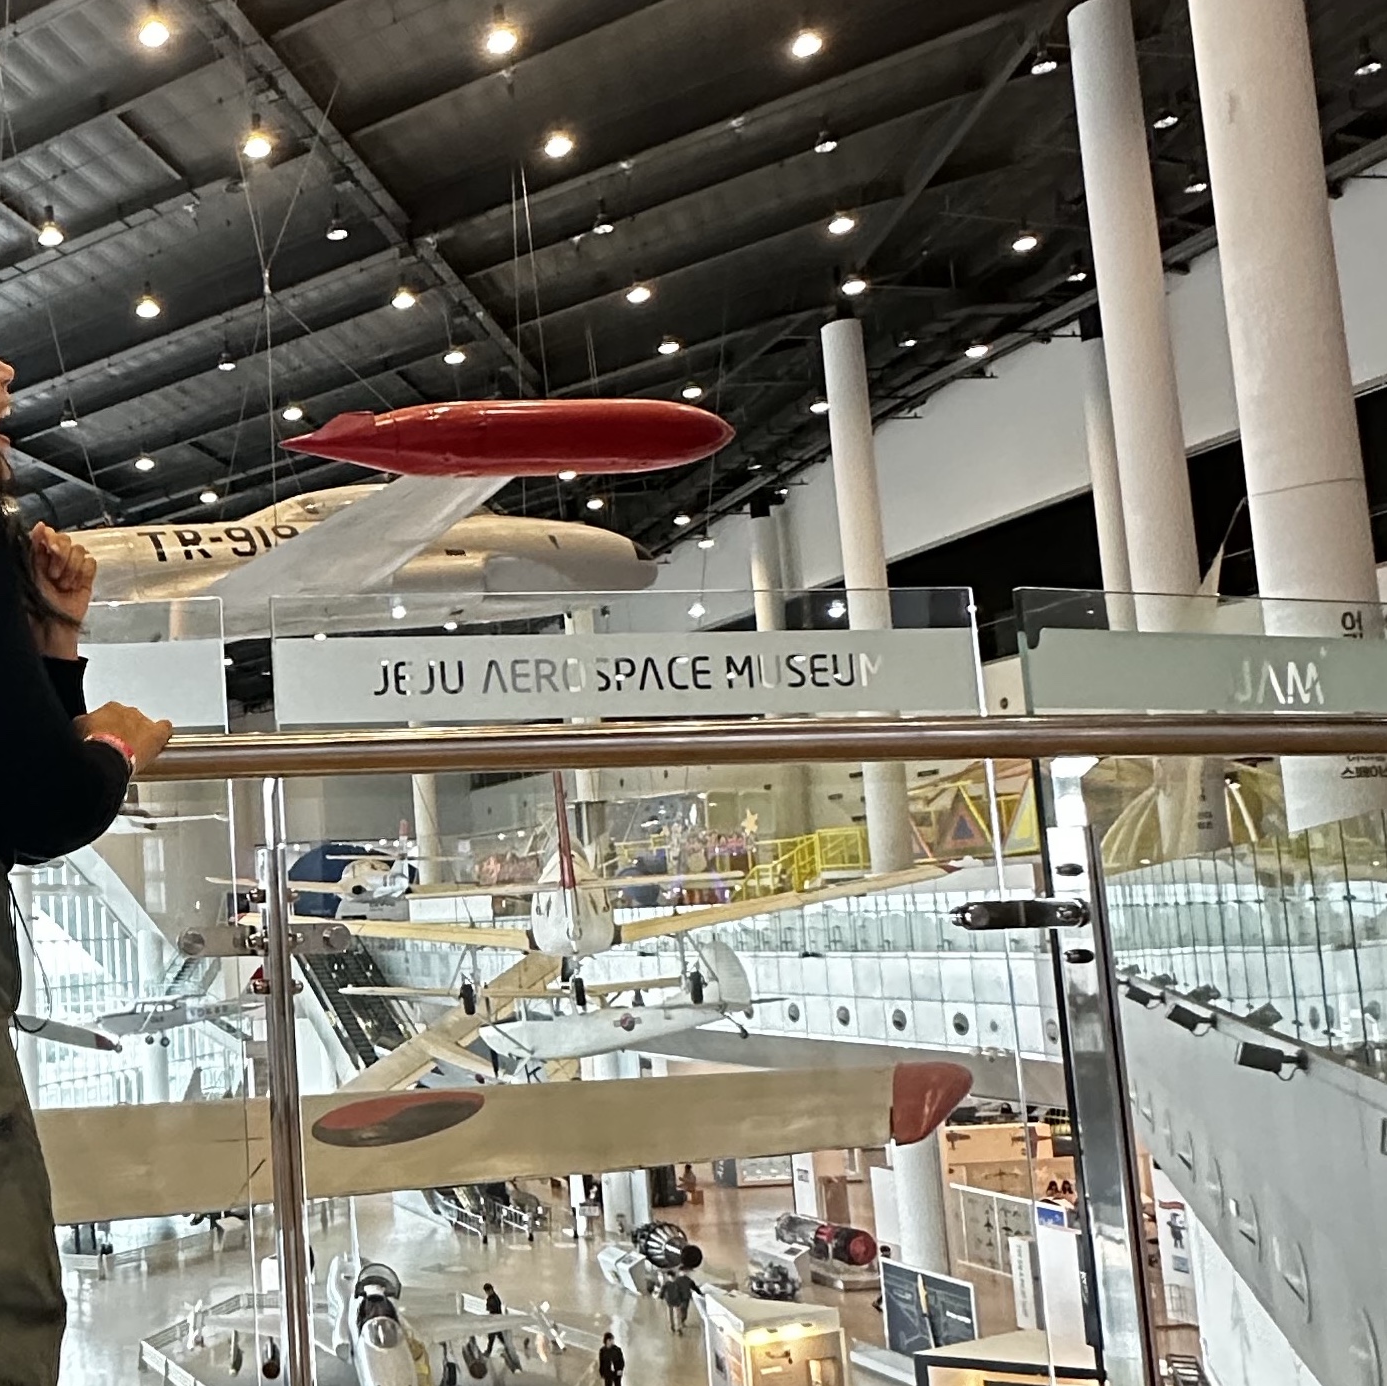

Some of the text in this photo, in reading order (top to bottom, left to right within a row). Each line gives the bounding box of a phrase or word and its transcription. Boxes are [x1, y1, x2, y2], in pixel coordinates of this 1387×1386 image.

[373, 652, 883, 696] JEJU AEROSPACE MUSEUM
